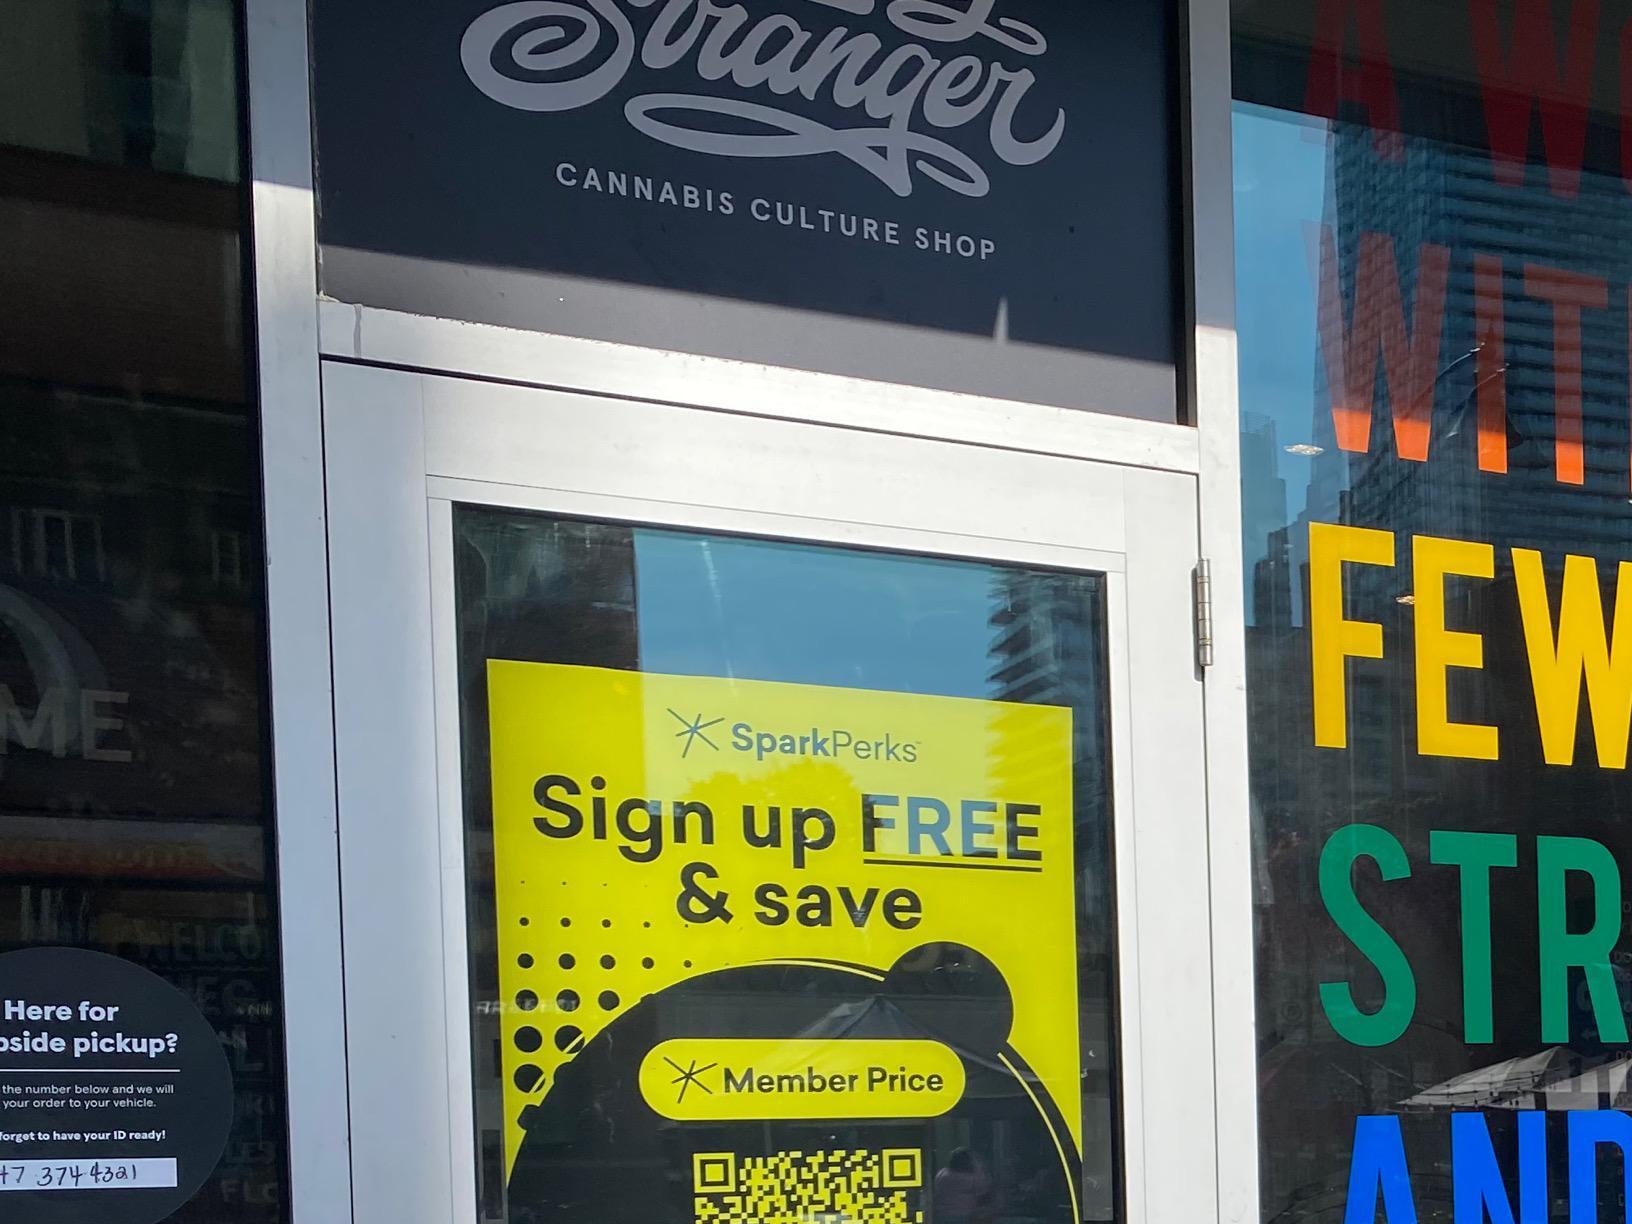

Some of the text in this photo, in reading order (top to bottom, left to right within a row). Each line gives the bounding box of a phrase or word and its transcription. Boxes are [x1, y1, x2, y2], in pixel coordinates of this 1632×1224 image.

[555, 162, 996, 261] CANNABIS CULTURE SHOP
[731, 723, 918, 762] SparkPerks
[532, 774, 1043, 869] Sign up FREE
[676, 862, 923, 930] & save
[4, 1000, 119, 1021] Here for
[74, 1031, 178, 1058] pickup?
[2, 1084, 174, 1094] the number below and we will
[723, 1066, 944, 1094] Member Price
[3, 1098, 157, 1110] your order to your vehicle.
[37, 1131, 50, 1141] to
[53, 1130, 81, 1140] have
[83, 1131, 111, 1142] your
[113, 1130, 127, 1140] ID
[129, 1130, 166, 1142] ready!
